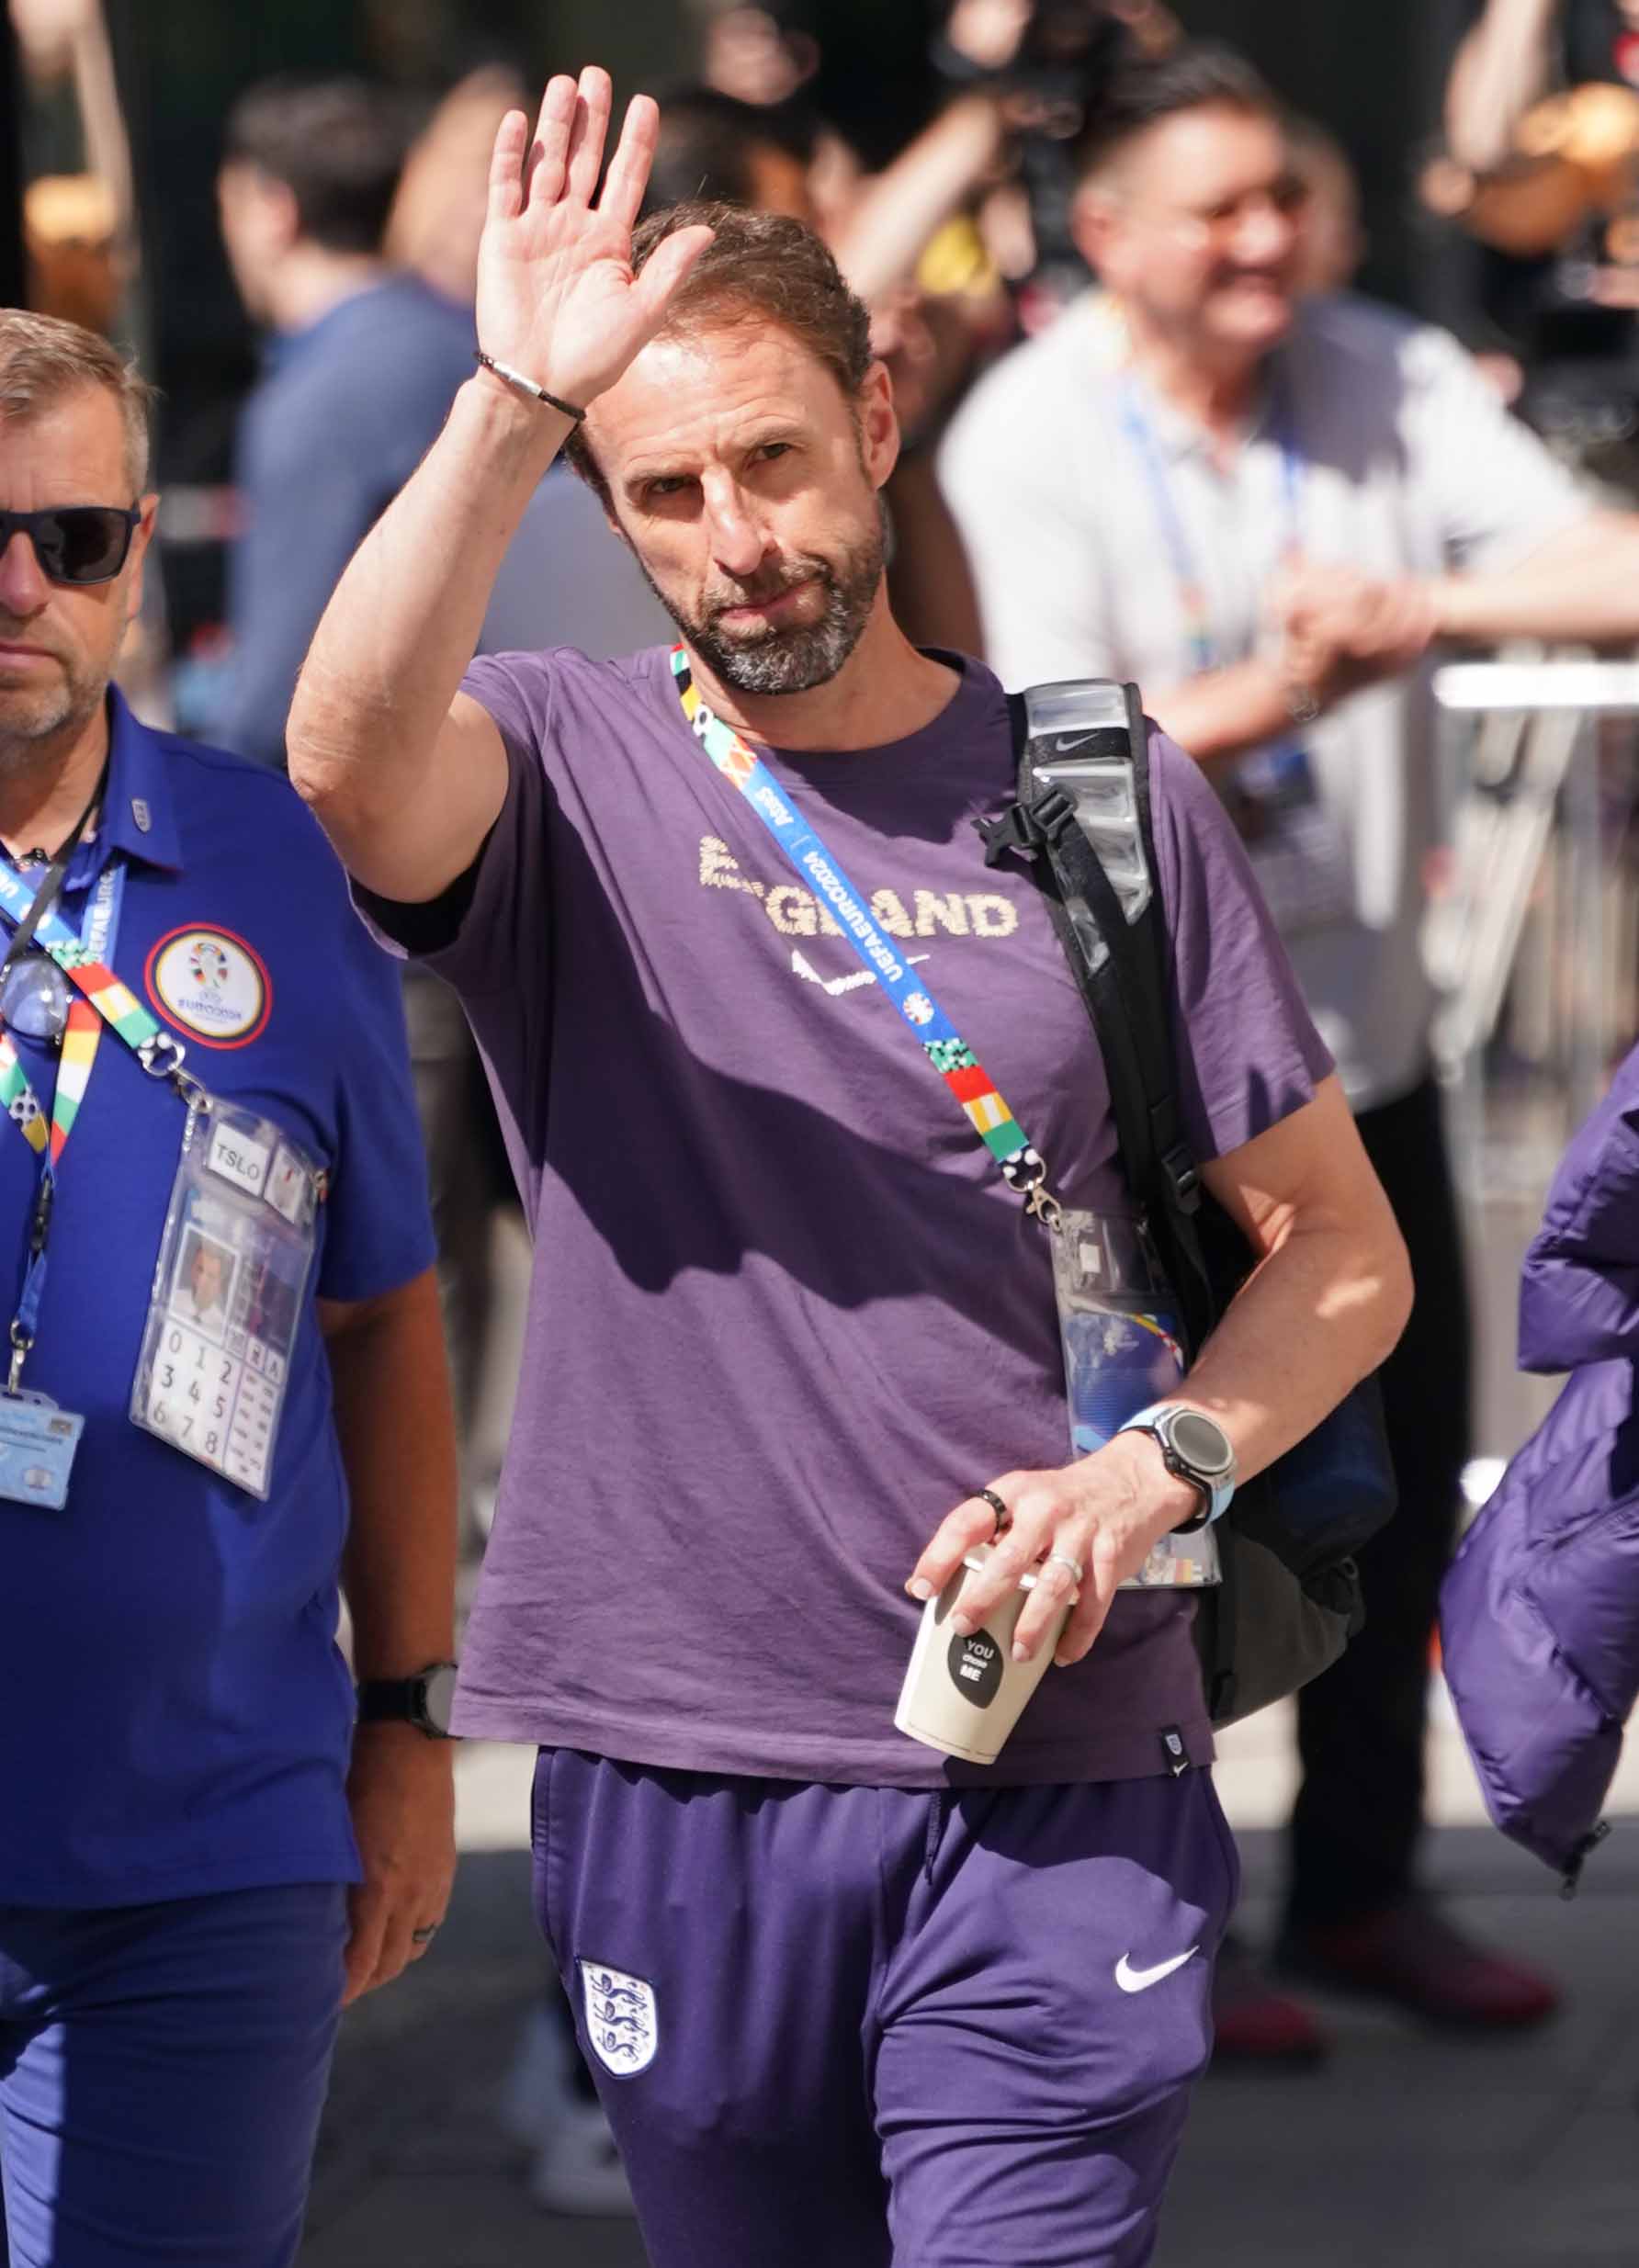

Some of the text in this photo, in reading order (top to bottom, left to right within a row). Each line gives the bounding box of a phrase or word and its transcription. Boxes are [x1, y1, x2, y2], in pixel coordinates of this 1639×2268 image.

[803, 851, 903, 983] UEFAEURO2024
[217, 1143, 260, 1180] TSLO
[169, 1330, 232, 1384] 0 1 2
[161, 1364, 226, 1418] 3 4 5
[153, 1401, 218, 1454] 6 7 8
[960, 1664, 982, 1682] ME
[967, 1639, 994, 1659] YOU
